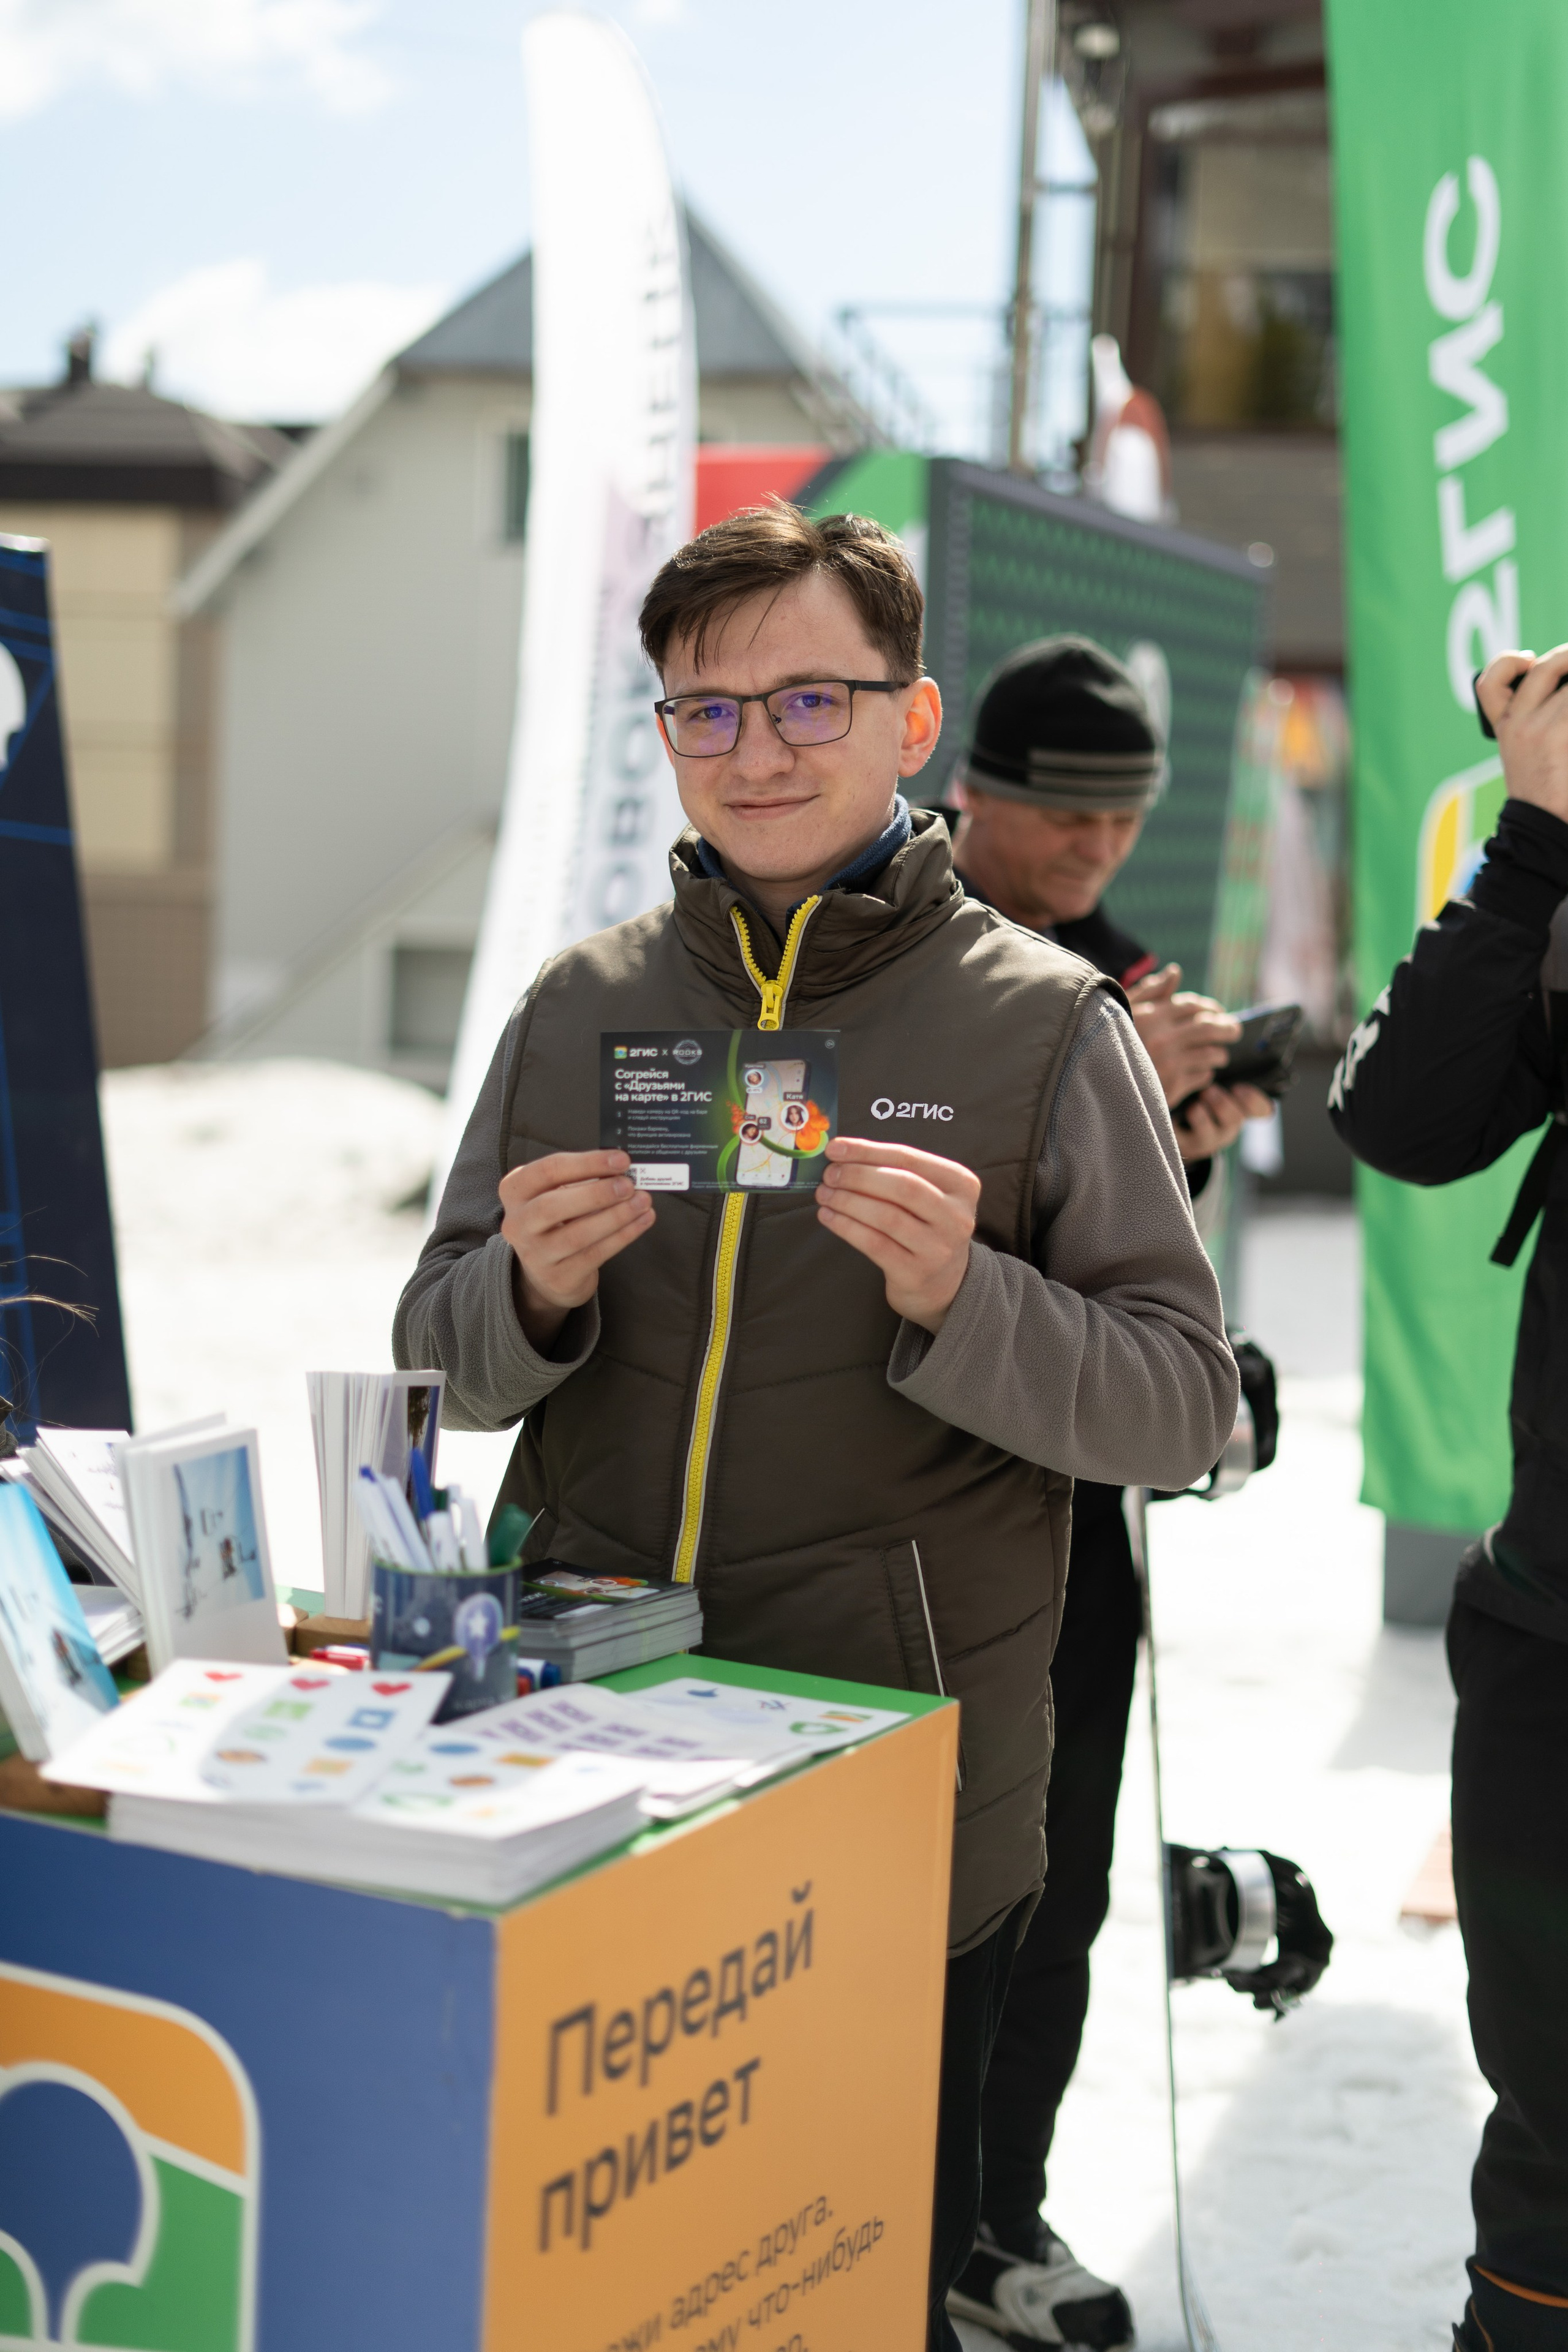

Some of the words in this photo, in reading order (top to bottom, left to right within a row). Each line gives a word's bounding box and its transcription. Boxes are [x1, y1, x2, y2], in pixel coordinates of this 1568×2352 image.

[1422, 153, 1521, 714] 2ГИС
[614, 1068, 669, 1081] Согрейся
[629, 1048, 658, 1057] 2ГИС
[624, 1081, 685, 1092] «Друзьями
[631, 1093, 669, 1103] карте»
[680, 1091, 712, 1102] 2ГИС
[896, 1102, 954, 1121] 2ГИС
[545, 1879, 815, 2117] Передай
[537, 2057, 762, 2253] привет
[669, 2246, 752, 2332] адрес
[756, 2194, 834, 2276] друга.
[747, 2214, 886, 2330] что-нибудь
